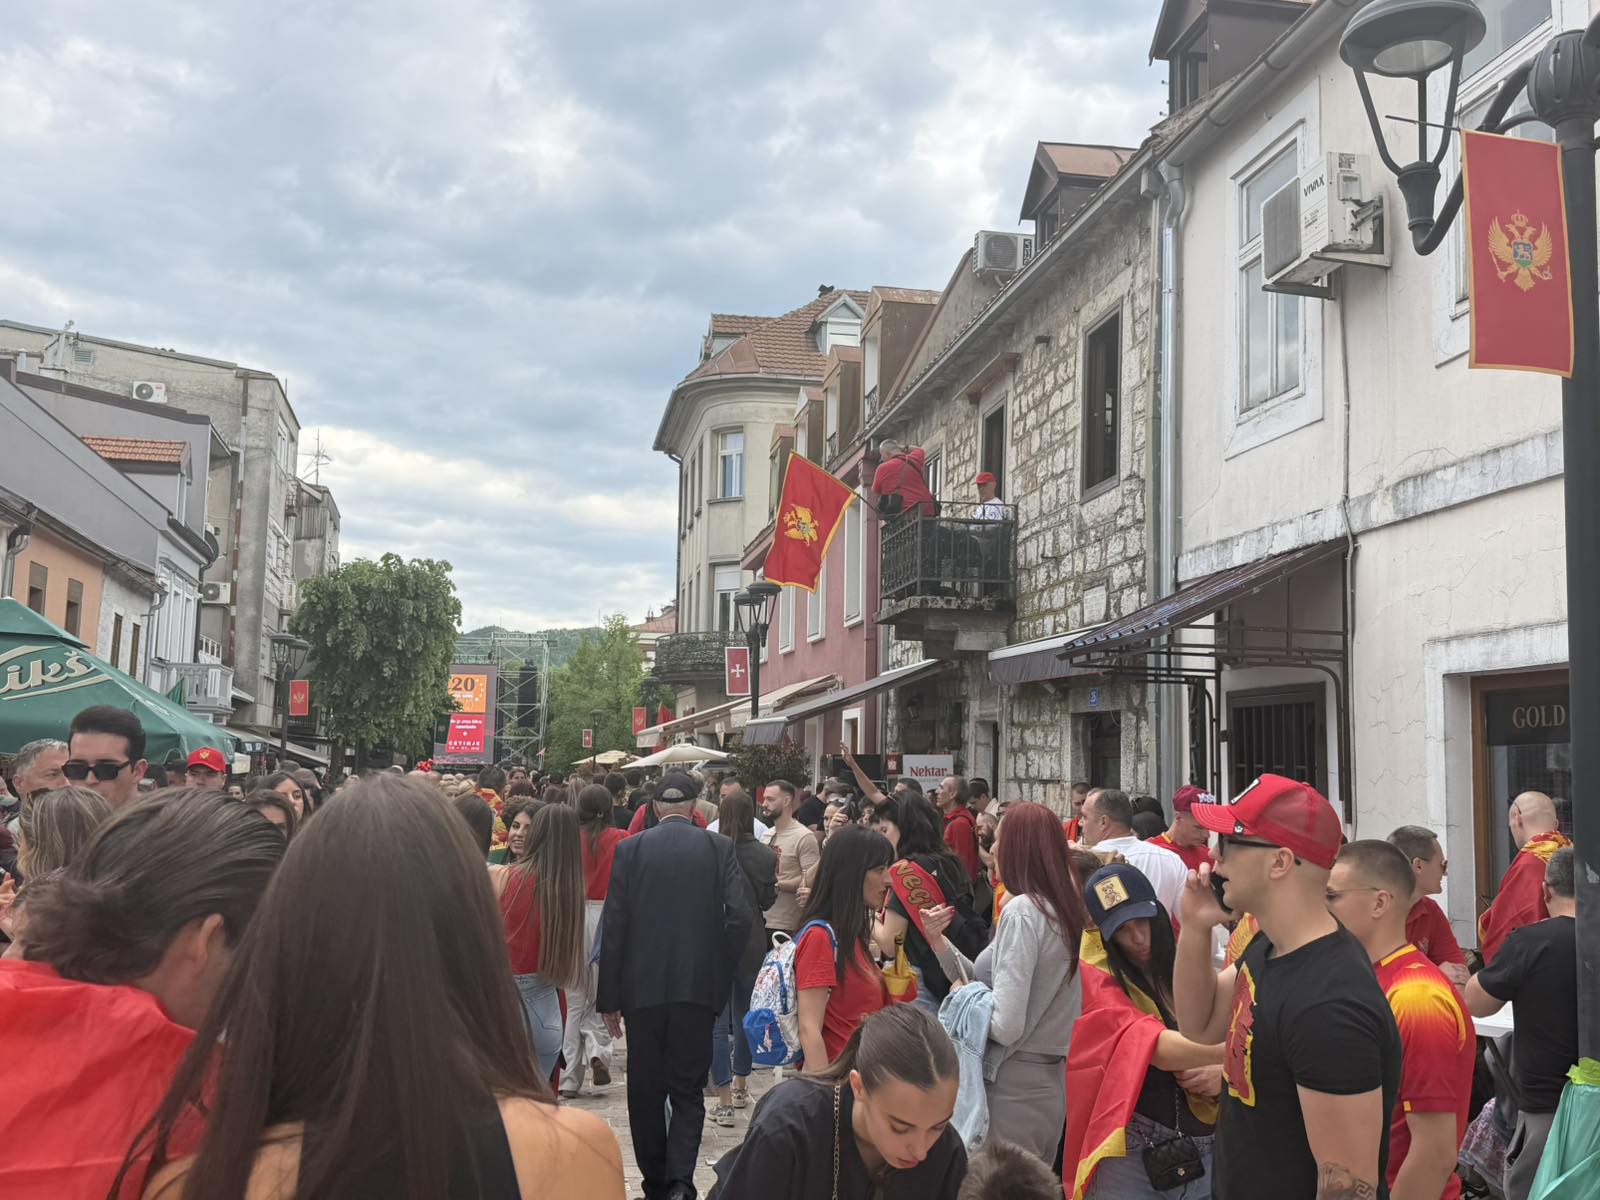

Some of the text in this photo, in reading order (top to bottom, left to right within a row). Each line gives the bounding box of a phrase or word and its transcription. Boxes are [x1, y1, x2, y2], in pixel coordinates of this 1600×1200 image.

[1303, 173, 1325, 197] VIVAX
[452, 677, 475, 691] 20
[1512, 704, 1566, 729] GOLD
[909, 765, 948, 777] Nektar
